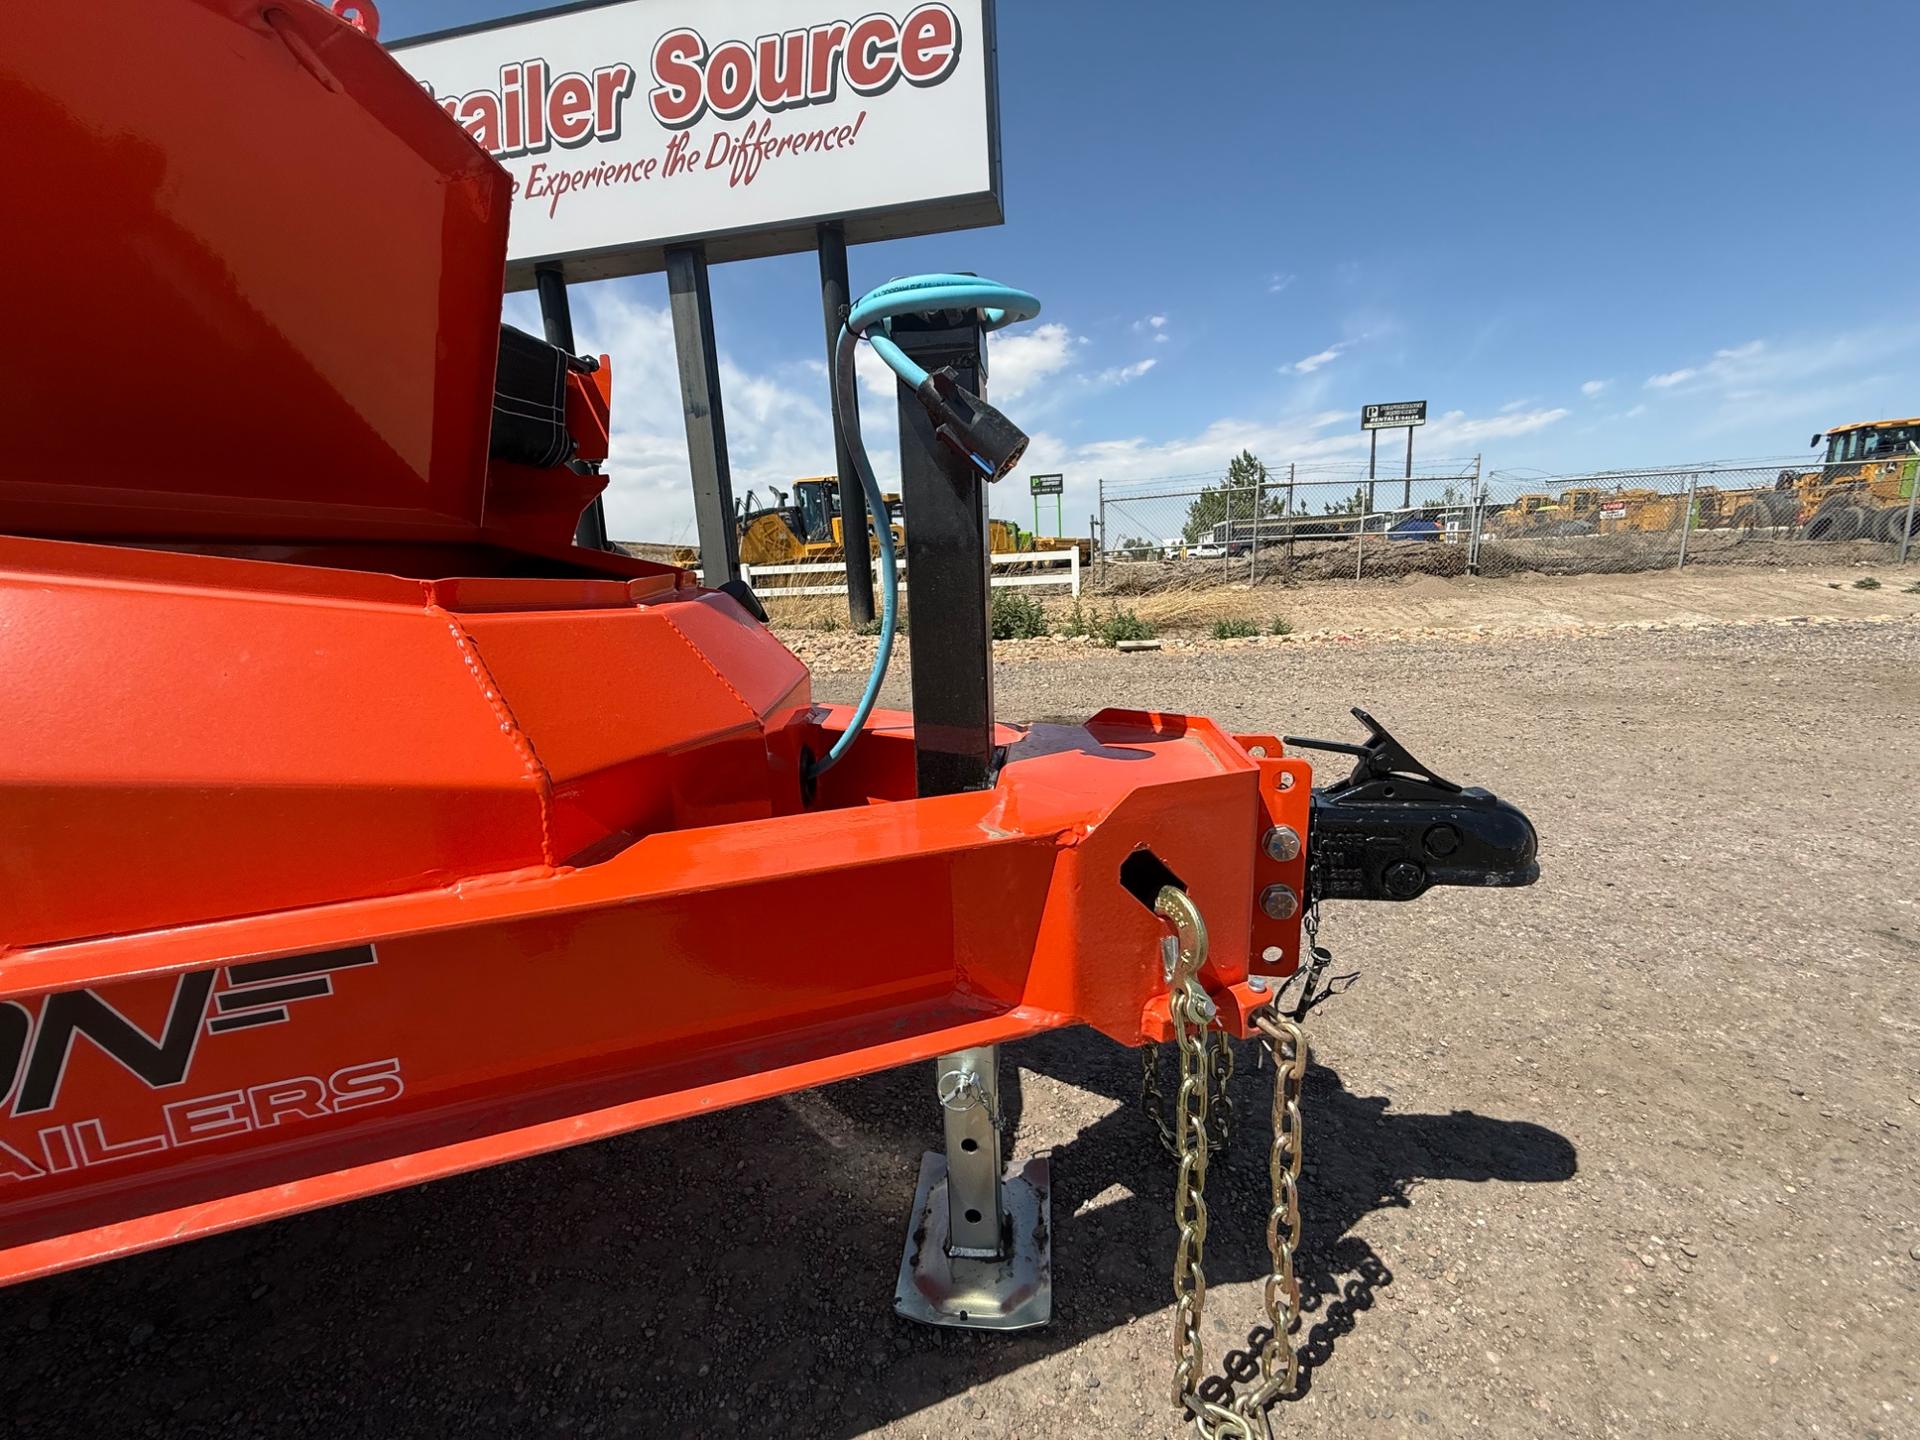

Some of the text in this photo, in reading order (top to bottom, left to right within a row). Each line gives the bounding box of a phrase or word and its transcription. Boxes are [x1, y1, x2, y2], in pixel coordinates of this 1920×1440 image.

[420, 3, 961, 160] ailer Source
[524, 111, 867, 219] Experience the Difference!
